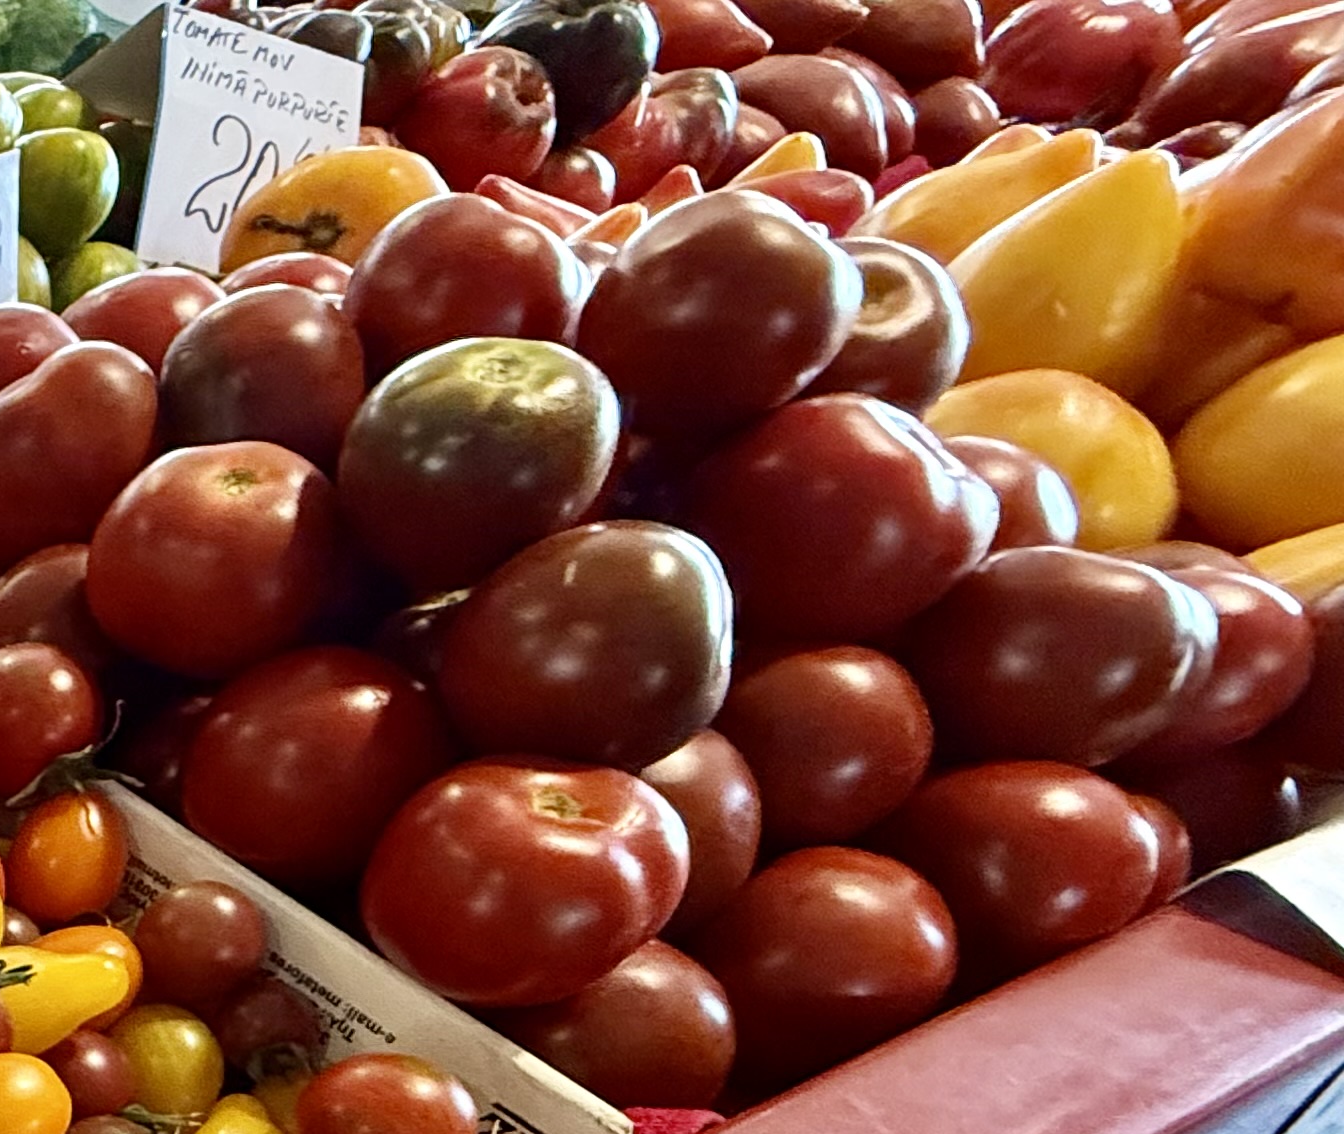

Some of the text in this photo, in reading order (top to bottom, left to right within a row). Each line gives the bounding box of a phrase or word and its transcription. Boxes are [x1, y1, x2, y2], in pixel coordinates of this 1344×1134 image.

[173, 8, 295, 71] TOMATE MOV
[268, 951, 343, 1008] metafores
